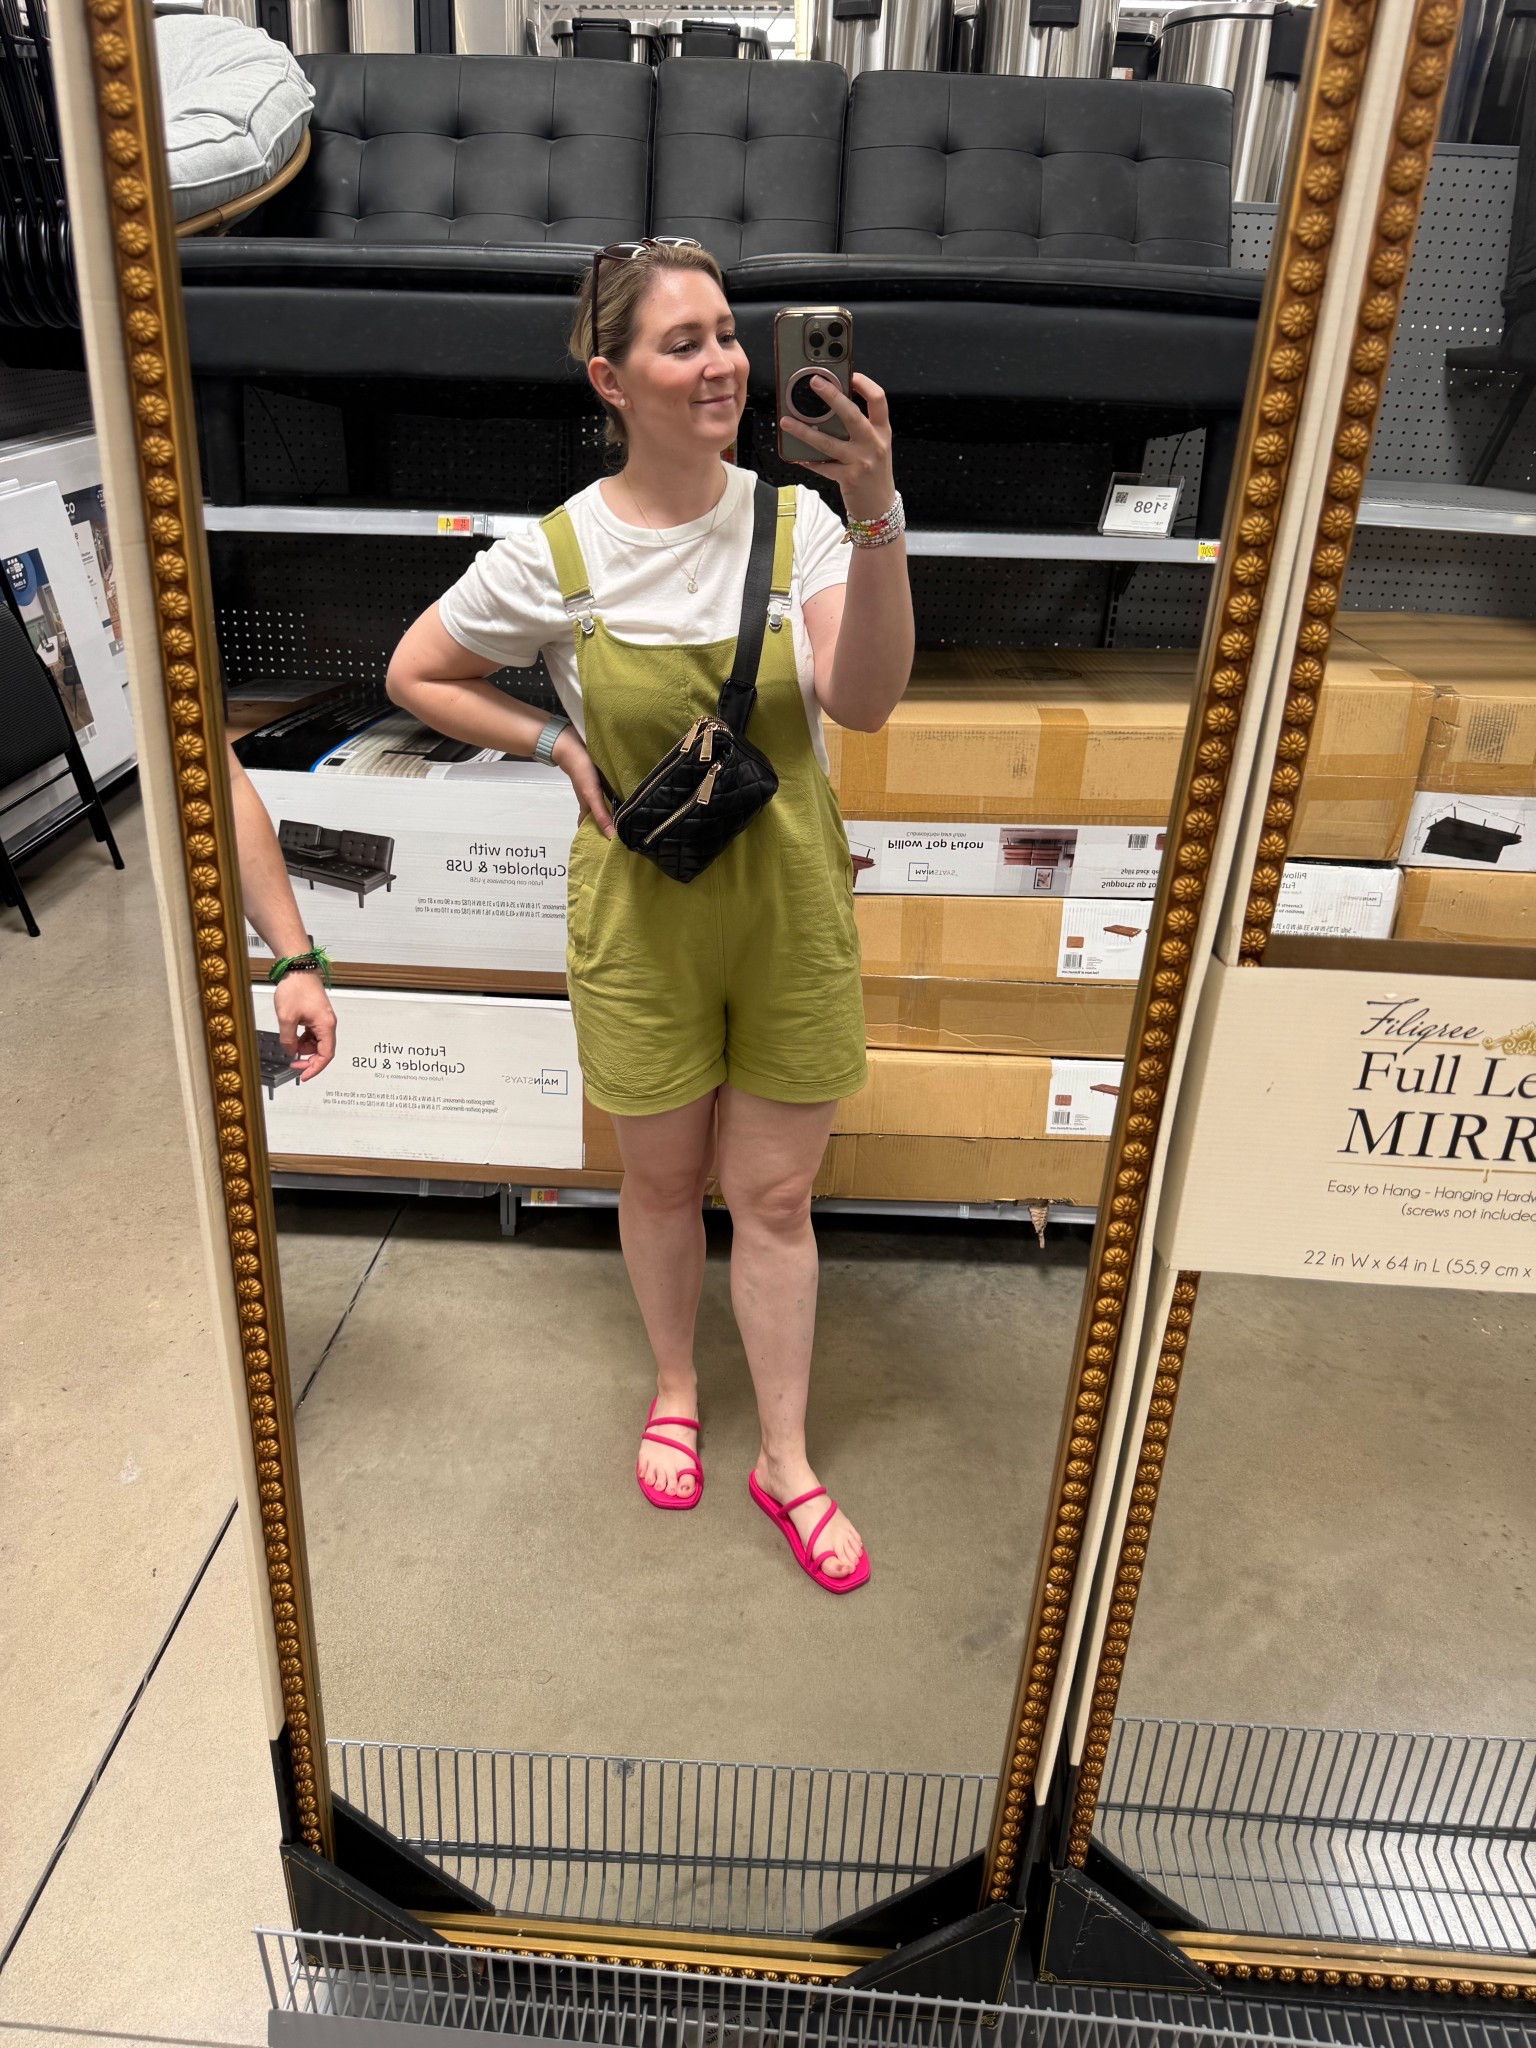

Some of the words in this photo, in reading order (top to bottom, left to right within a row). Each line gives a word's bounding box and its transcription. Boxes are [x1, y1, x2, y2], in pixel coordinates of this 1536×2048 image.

[1360, 998, 1484, 1055] Filigree
[1352, 1051, 1461, 1095] Full
[1337, 1108, 1536, 1163] MIRR
[1327, 1180, 1360, 1195] Easy
[1364, 1183, 1379, 1195] to
[1383, 1184, 1421, 1199] Hang
[1434, 1187, 1493, 1202] Hanging
[1401, 1203, 1449, 1218] (screws
[1454, 1208, 1477, 1219] not
[1304, 1250, 1326, 1265] 22
[1332, 1253, 1344, 1266] in
[1352, 1253, 1369, 1268] W
[1372, 1259, 1380, 1269] x
[1386, 1256, 1408, 1271] 64
[1414, 1259, 1427, 1272] in
[1433, 1259, 1441, 1273] L
[1446, 1258, 1490, 1275] (55.9
[1495, 1264, 1518, 1277] cm
[1523, 1267, 1532, 1277] x
